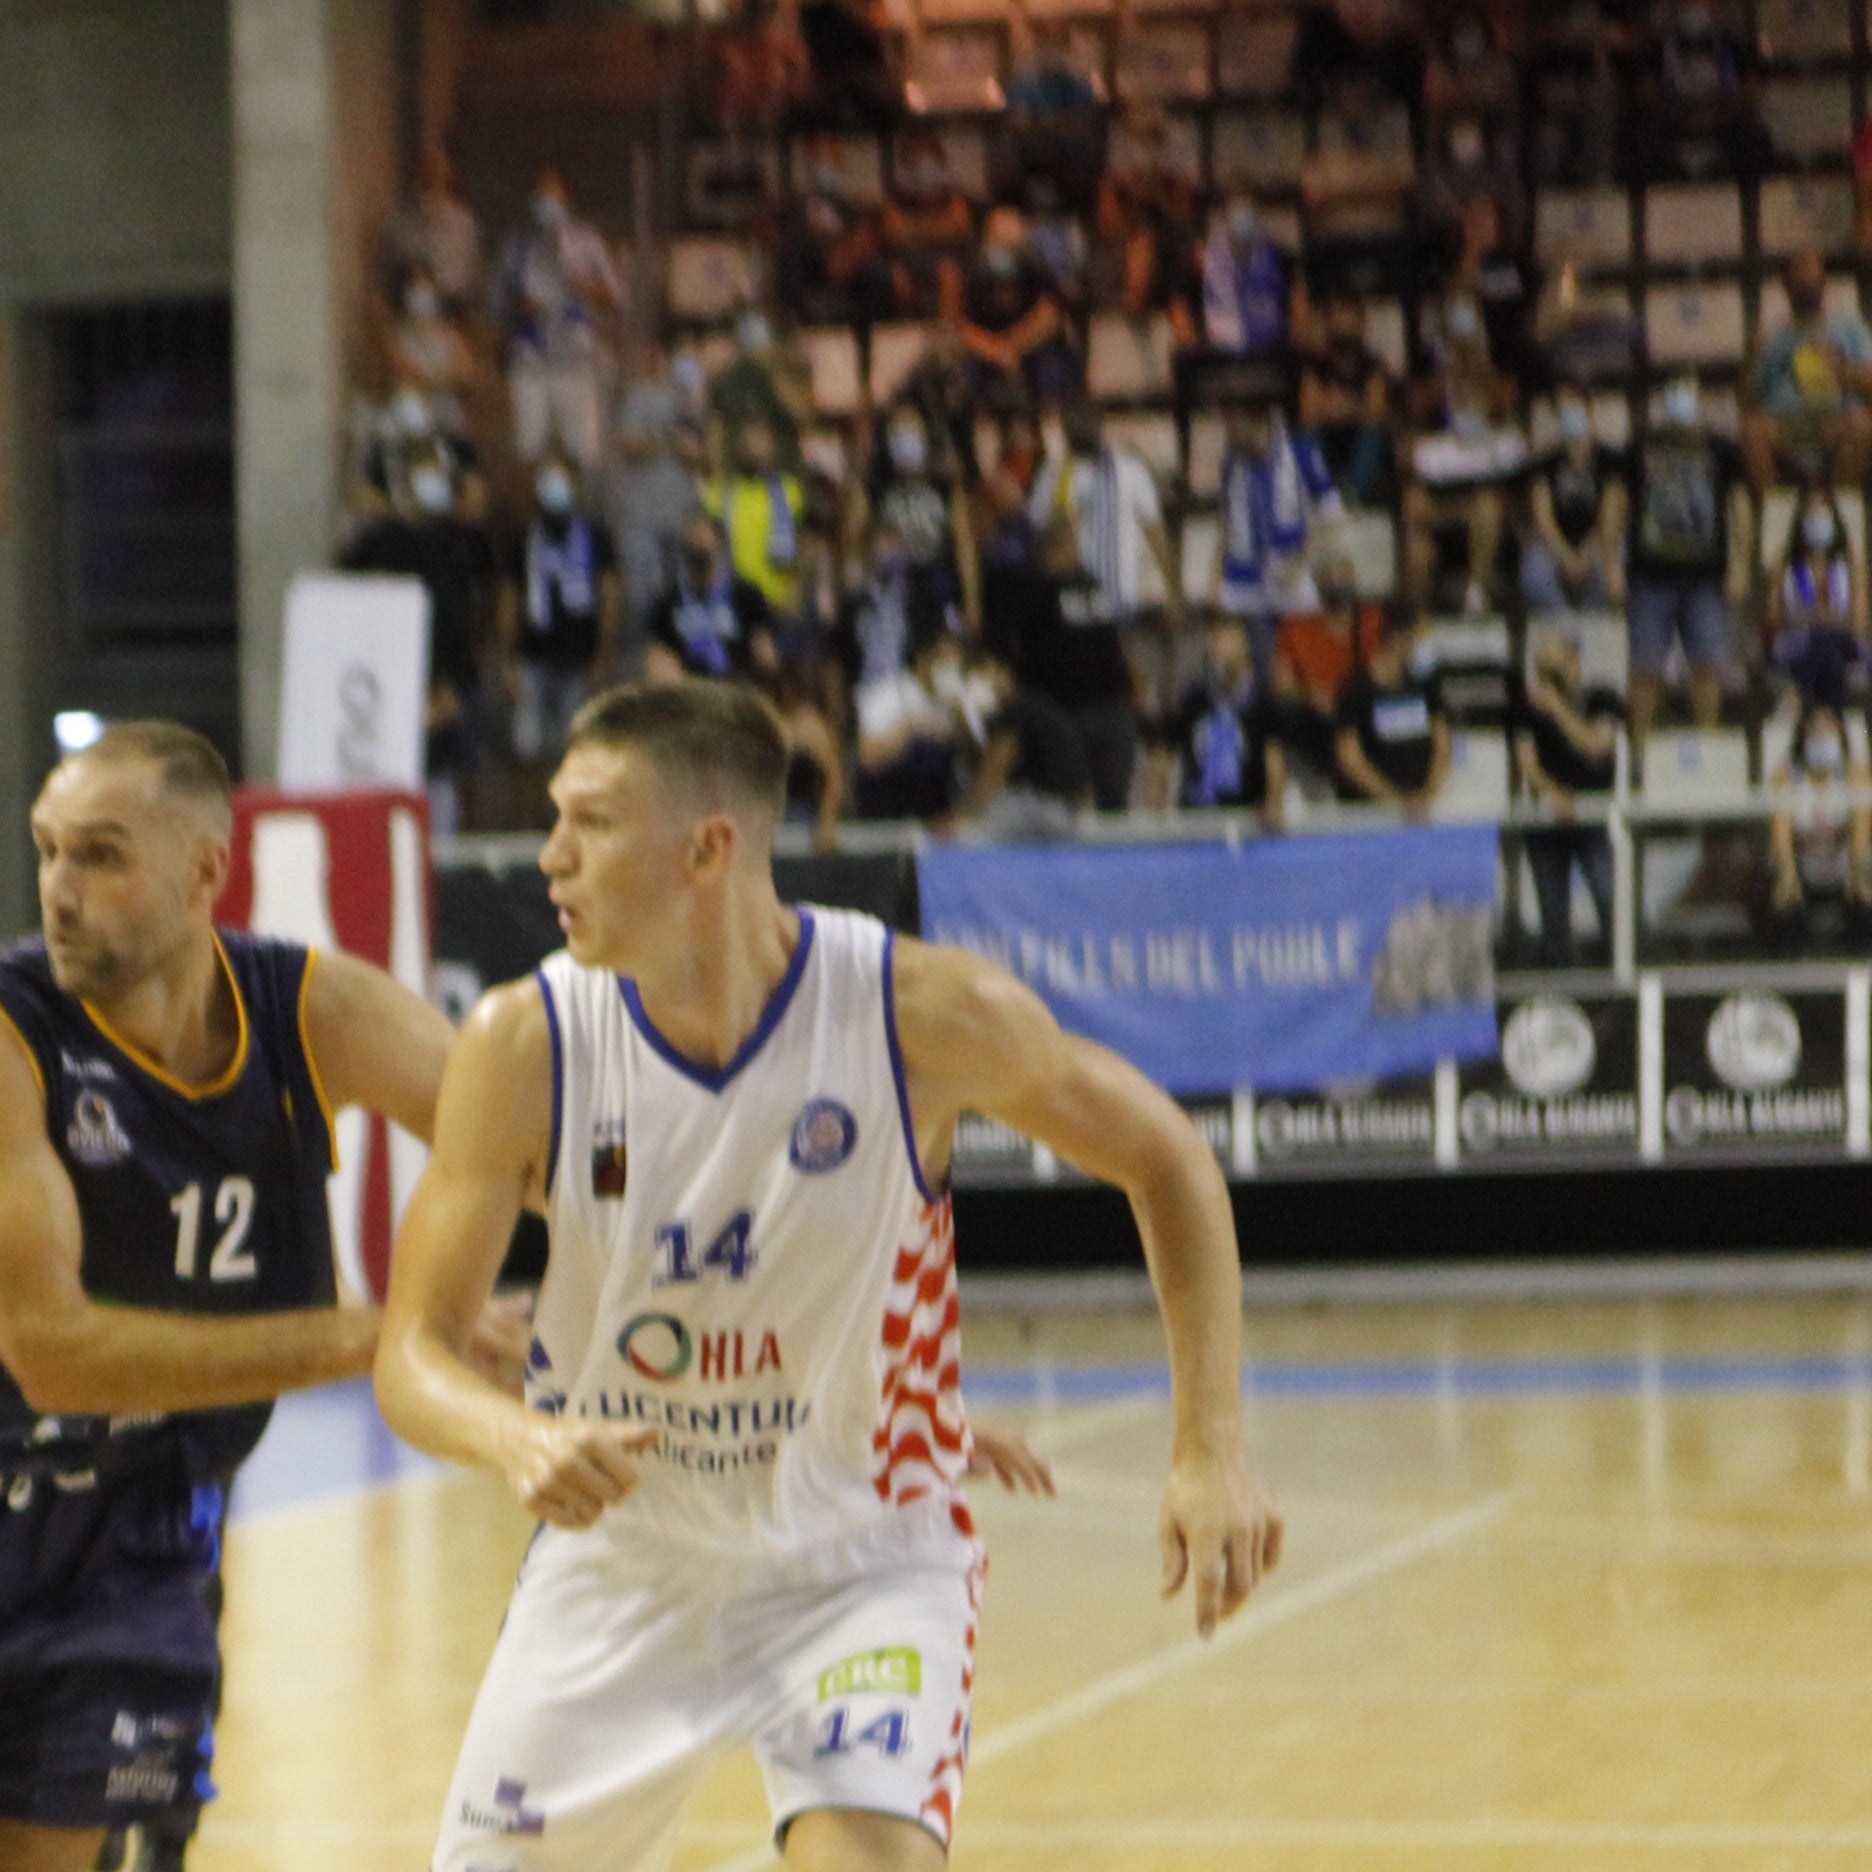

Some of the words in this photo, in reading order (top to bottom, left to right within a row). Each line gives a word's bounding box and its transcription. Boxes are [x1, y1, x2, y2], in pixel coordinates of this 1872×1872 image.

[170, 1176, 257, 1283] 12
[652, 1208, 756, 1288] 14
[812, 1704, 912, 1760] 14
